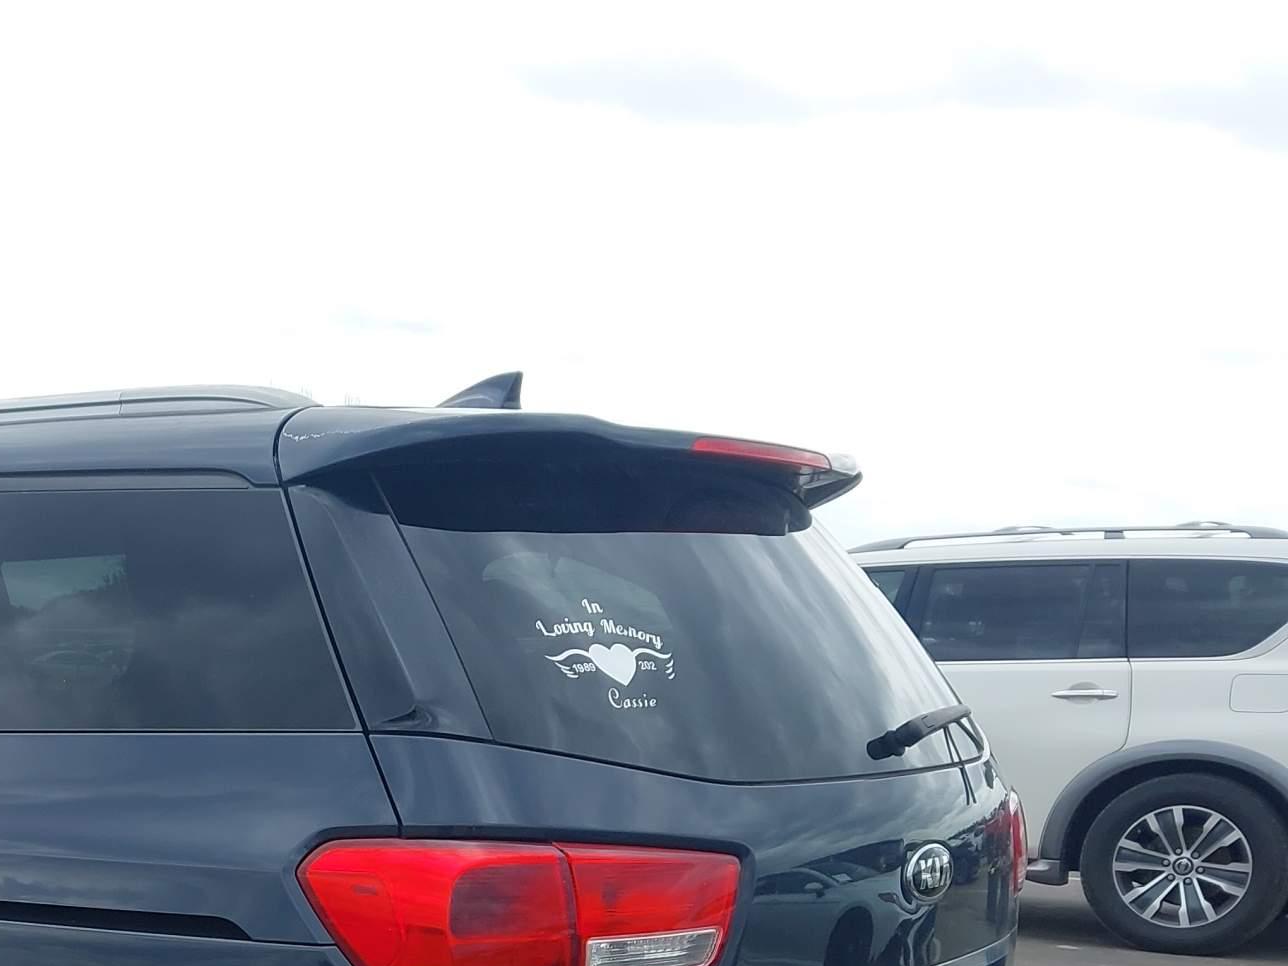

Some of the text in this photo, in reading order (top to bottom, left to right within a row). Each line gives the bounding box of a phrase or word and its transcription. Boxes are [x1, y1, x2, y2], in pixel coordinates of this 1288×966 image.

[581, 598, 603, 614] In
[535, 617, 663, 649] Loving Memory
[572, 662, 596, 673] 1989
[608, 687, 657, 709] Cassie
